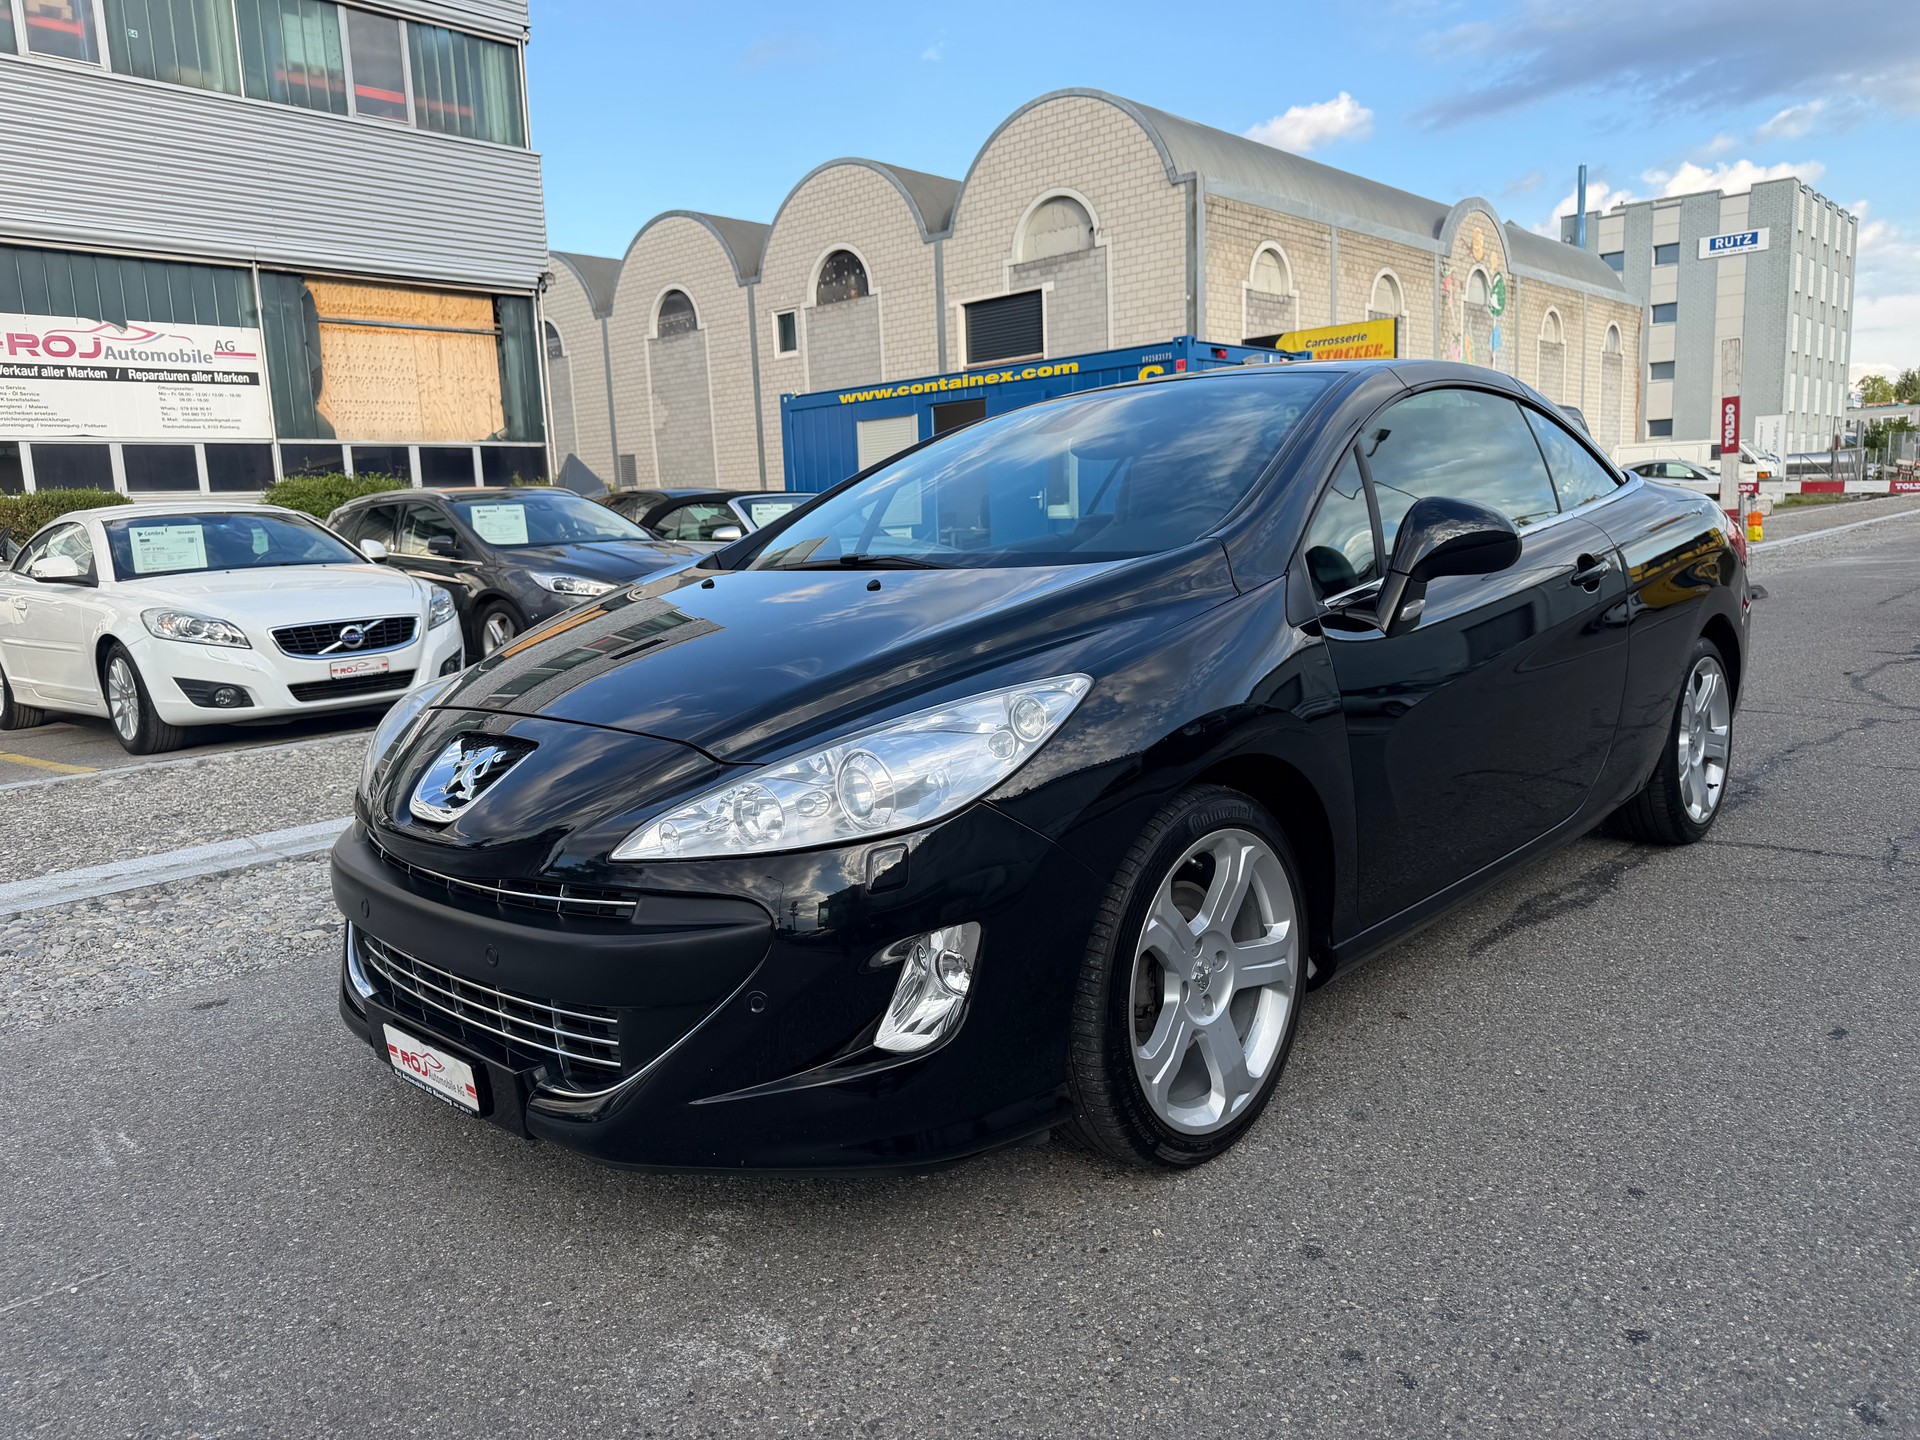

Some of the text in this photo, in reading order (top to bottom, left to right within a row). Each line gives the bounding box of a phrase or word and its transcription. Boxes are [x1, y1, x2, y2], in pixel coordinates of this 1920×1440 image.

[1715, 233, 1753, 249] RUTZ
[6, 333, 235, 364] ROJ Automobile AG
[1305, 332, 1367, 348] Carrosserie
[1316, 343, 1383, 360] STOCKER
[41, 366, 64, 377] aller
[67, 367, 107, 379] Marken
[128, 369, 189, 382] Reparaturen
[191, 371, 212, 382] aller
[214, 372, 250, 383] Marken
[839, 362, 1079, 404] www.containex.com
[1725, 403, 1736, 447] TOLDO
[400, 1049, 429, 1077] ROJ
